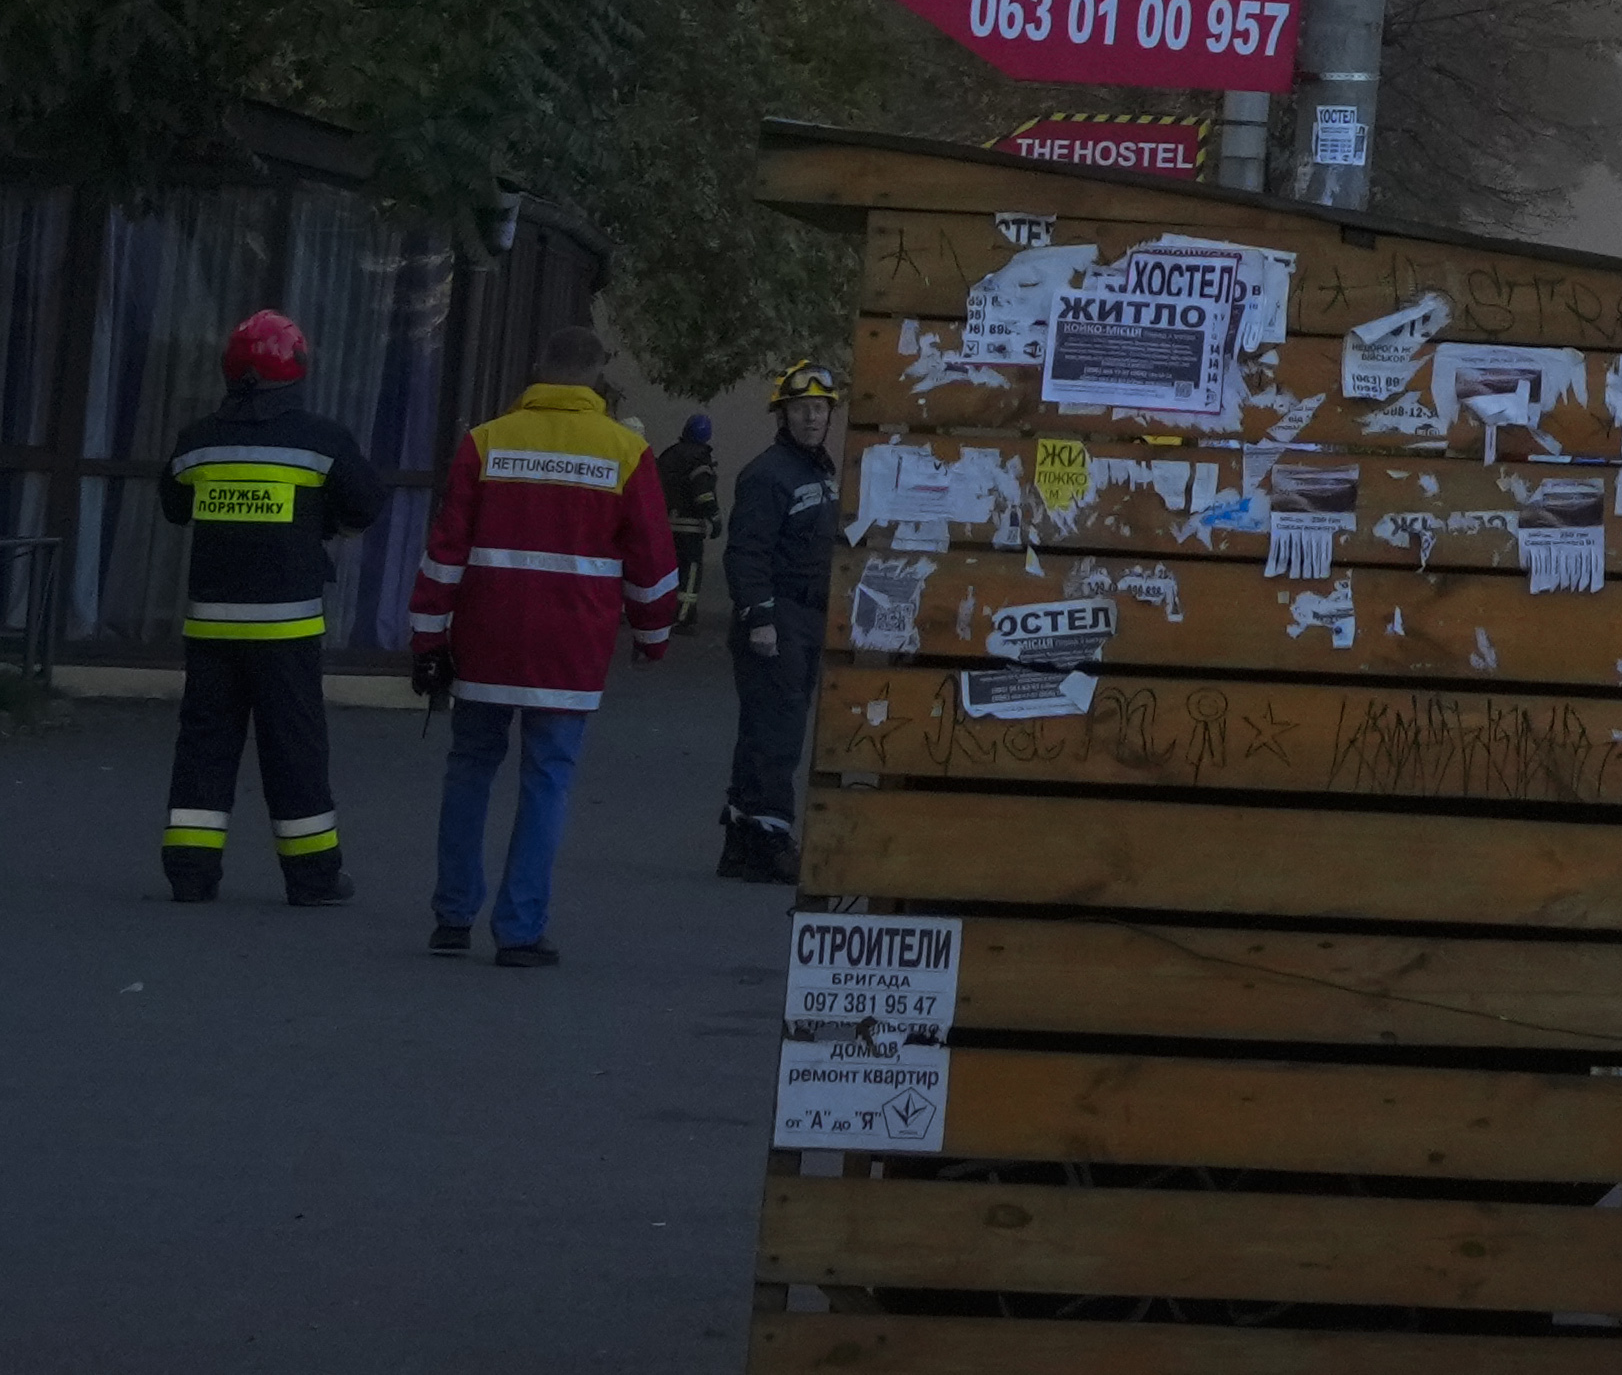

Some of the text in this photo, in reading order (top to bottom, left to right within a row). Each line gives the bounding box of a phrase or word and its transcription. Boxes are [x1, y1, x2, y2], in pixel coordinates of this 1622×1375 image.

[1074, 139, 1194, 169] HOSTEL
[1131, 261, 1233, 304] ХОСТЕЛ
[1058, 296, 1206, 328] ЖИТЛО
[493, 456, 615, 480] RETTUNGSDIENST
[209, 488, 271, 501] СЛУЖБА
[198, 501, 284, 515] ПОРЯТУНКУ
[996, 607, 1112, 637] ОСТЕЛ
[797, 924, 952, 970] СТРОИТЕЛИ
[832, 972, 911, 989] БРИГАДА
[804, 992, 937, 1016] 097 381 95 47
[788, 1069, 939, 1090] ремонт квартир
[786, 1118, 802, 1129] от
[832, 1118, 851, 1131] до
